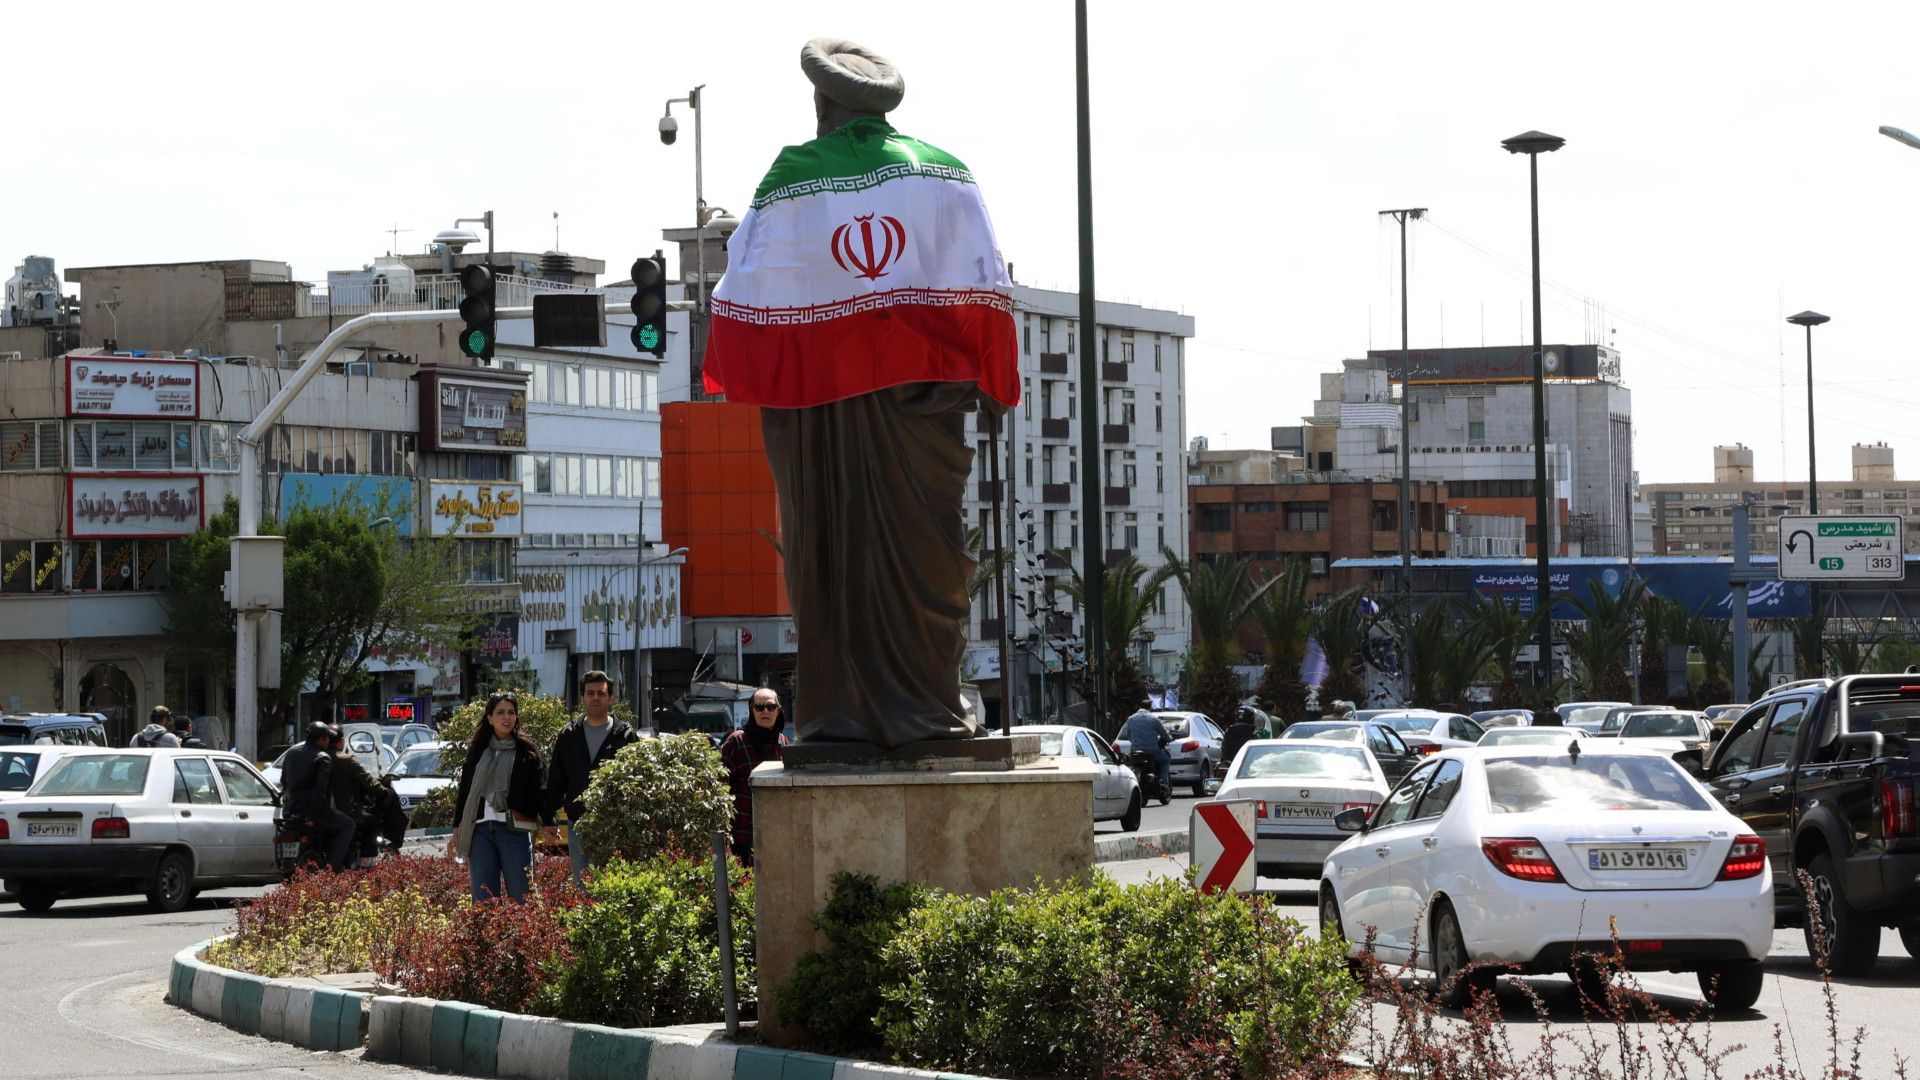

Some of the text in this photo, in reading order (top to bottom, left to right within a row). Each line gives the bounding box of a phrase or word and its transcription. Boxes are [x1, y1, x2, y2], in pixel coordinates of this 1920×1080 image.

[130, 371, 154, 390] بزرگ
[157, 375, 192, 387] مسکن
[1820, 522, 1882, 535] شهید مدرس
[1844, 538, 1882, 551] شریعتی
[1825, 558, 1892, 570] 15 313
